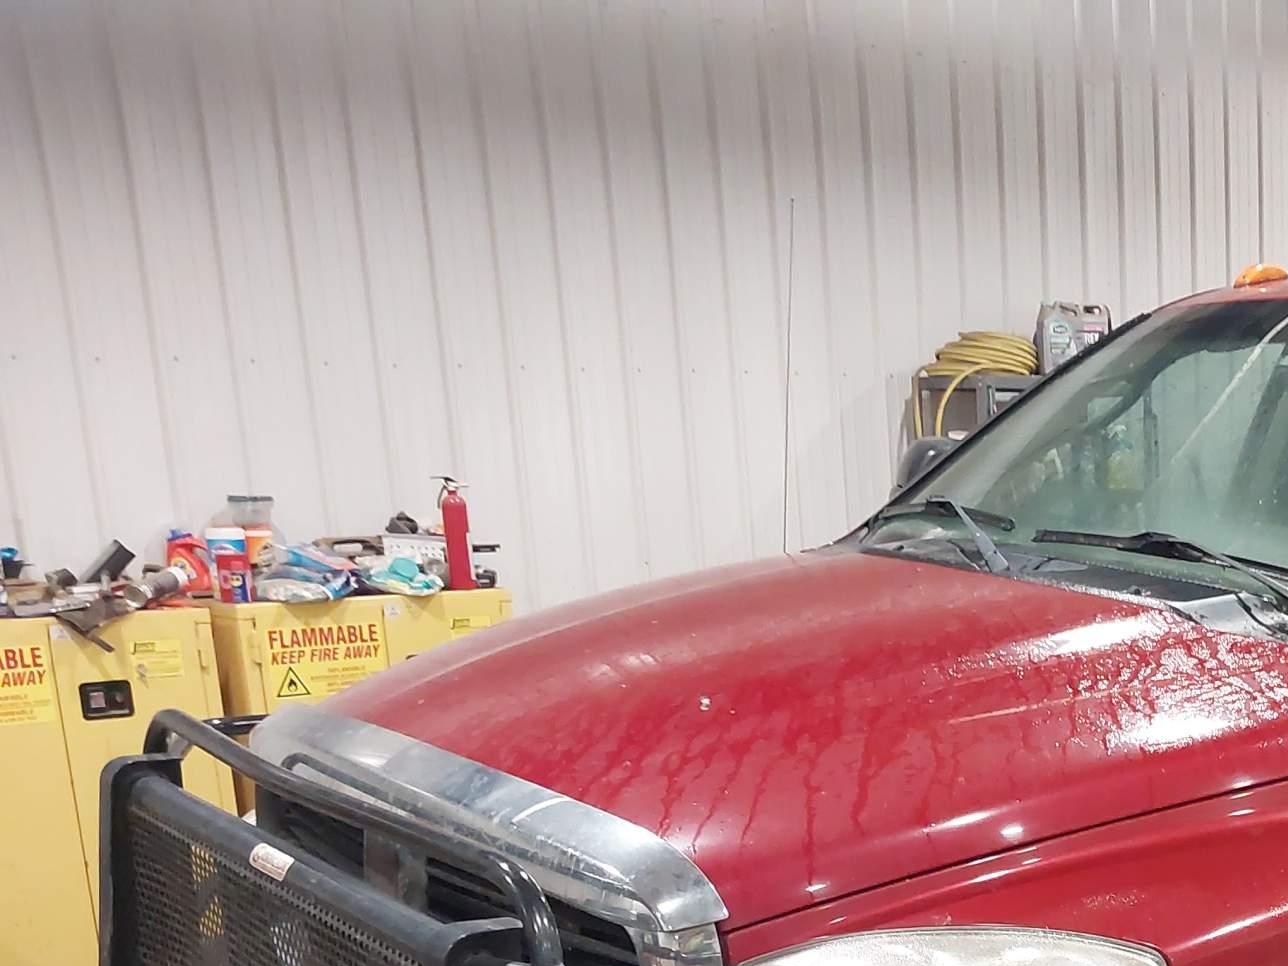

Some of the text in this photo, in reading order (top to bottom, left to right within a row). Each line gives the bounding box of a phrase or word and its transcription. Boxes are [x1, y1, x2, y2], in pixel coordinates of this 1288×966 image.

[267, 624, 379, 650] FLAMMABLE
[271, 644, 380, 666] KEEP FIRE AWAY
[1, 669, 46, 688] AWAY
